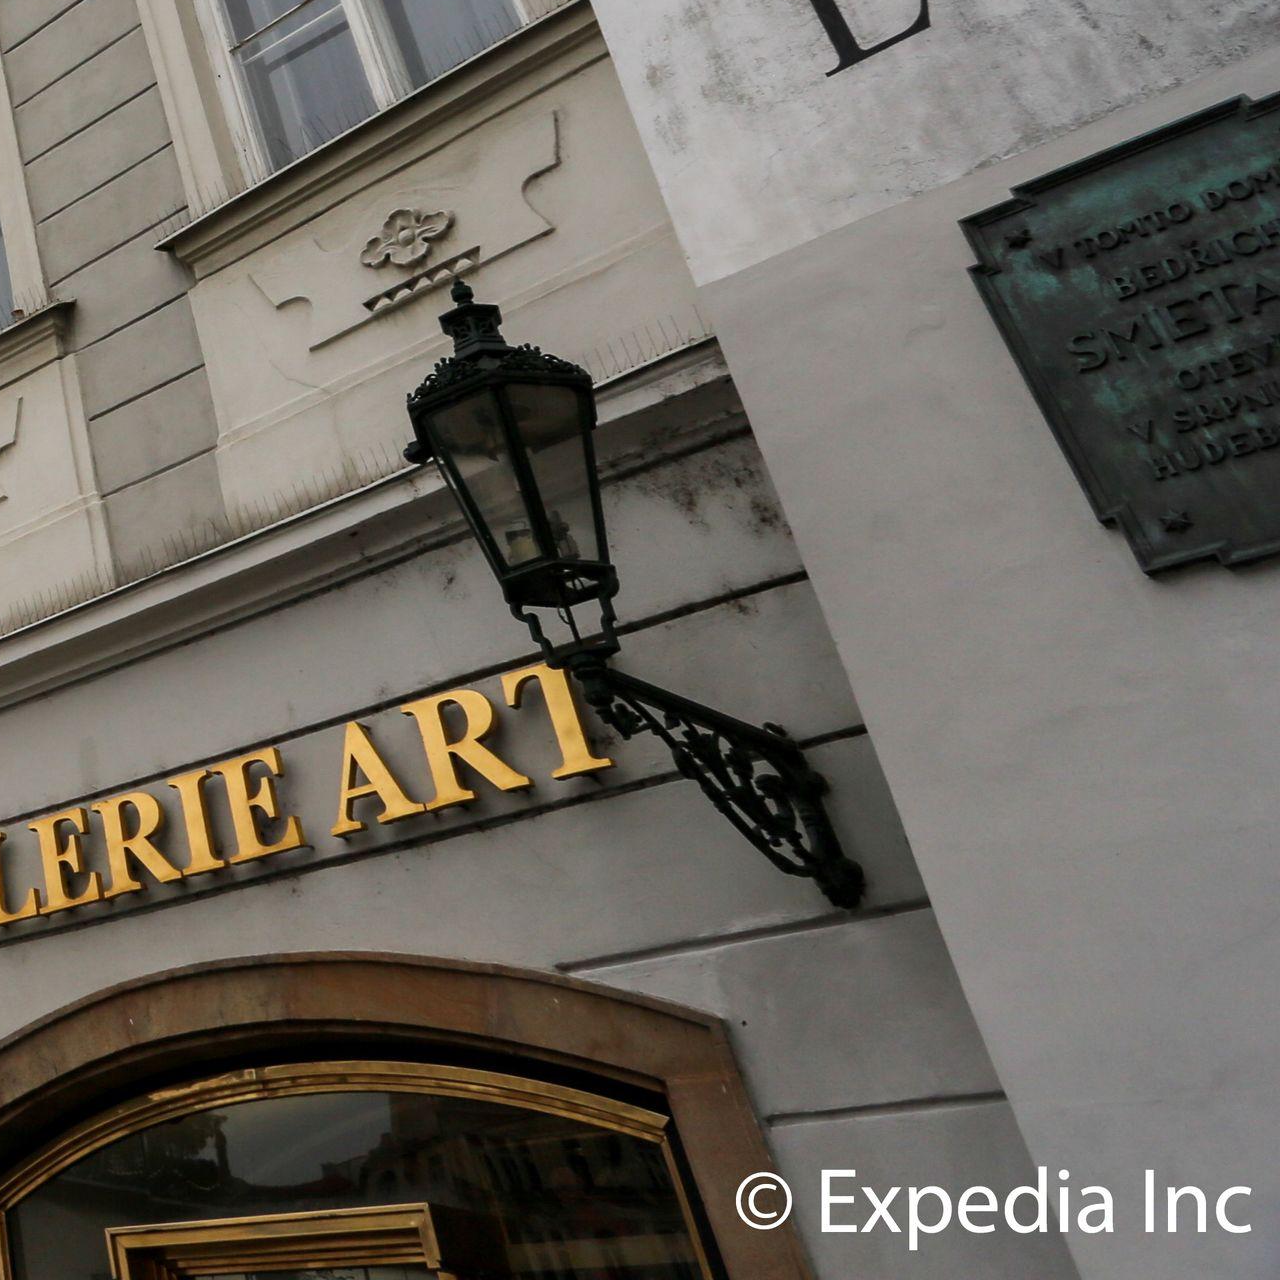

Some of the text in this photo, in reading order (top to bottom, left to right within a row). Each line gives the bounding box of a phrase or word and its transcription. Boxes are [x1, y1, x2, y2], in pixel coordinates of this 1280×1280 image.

[1174, 332, 1280, 393] OTEV
[1125, 418, 1155, 447] V
[330, 662, 615, 838] ART
